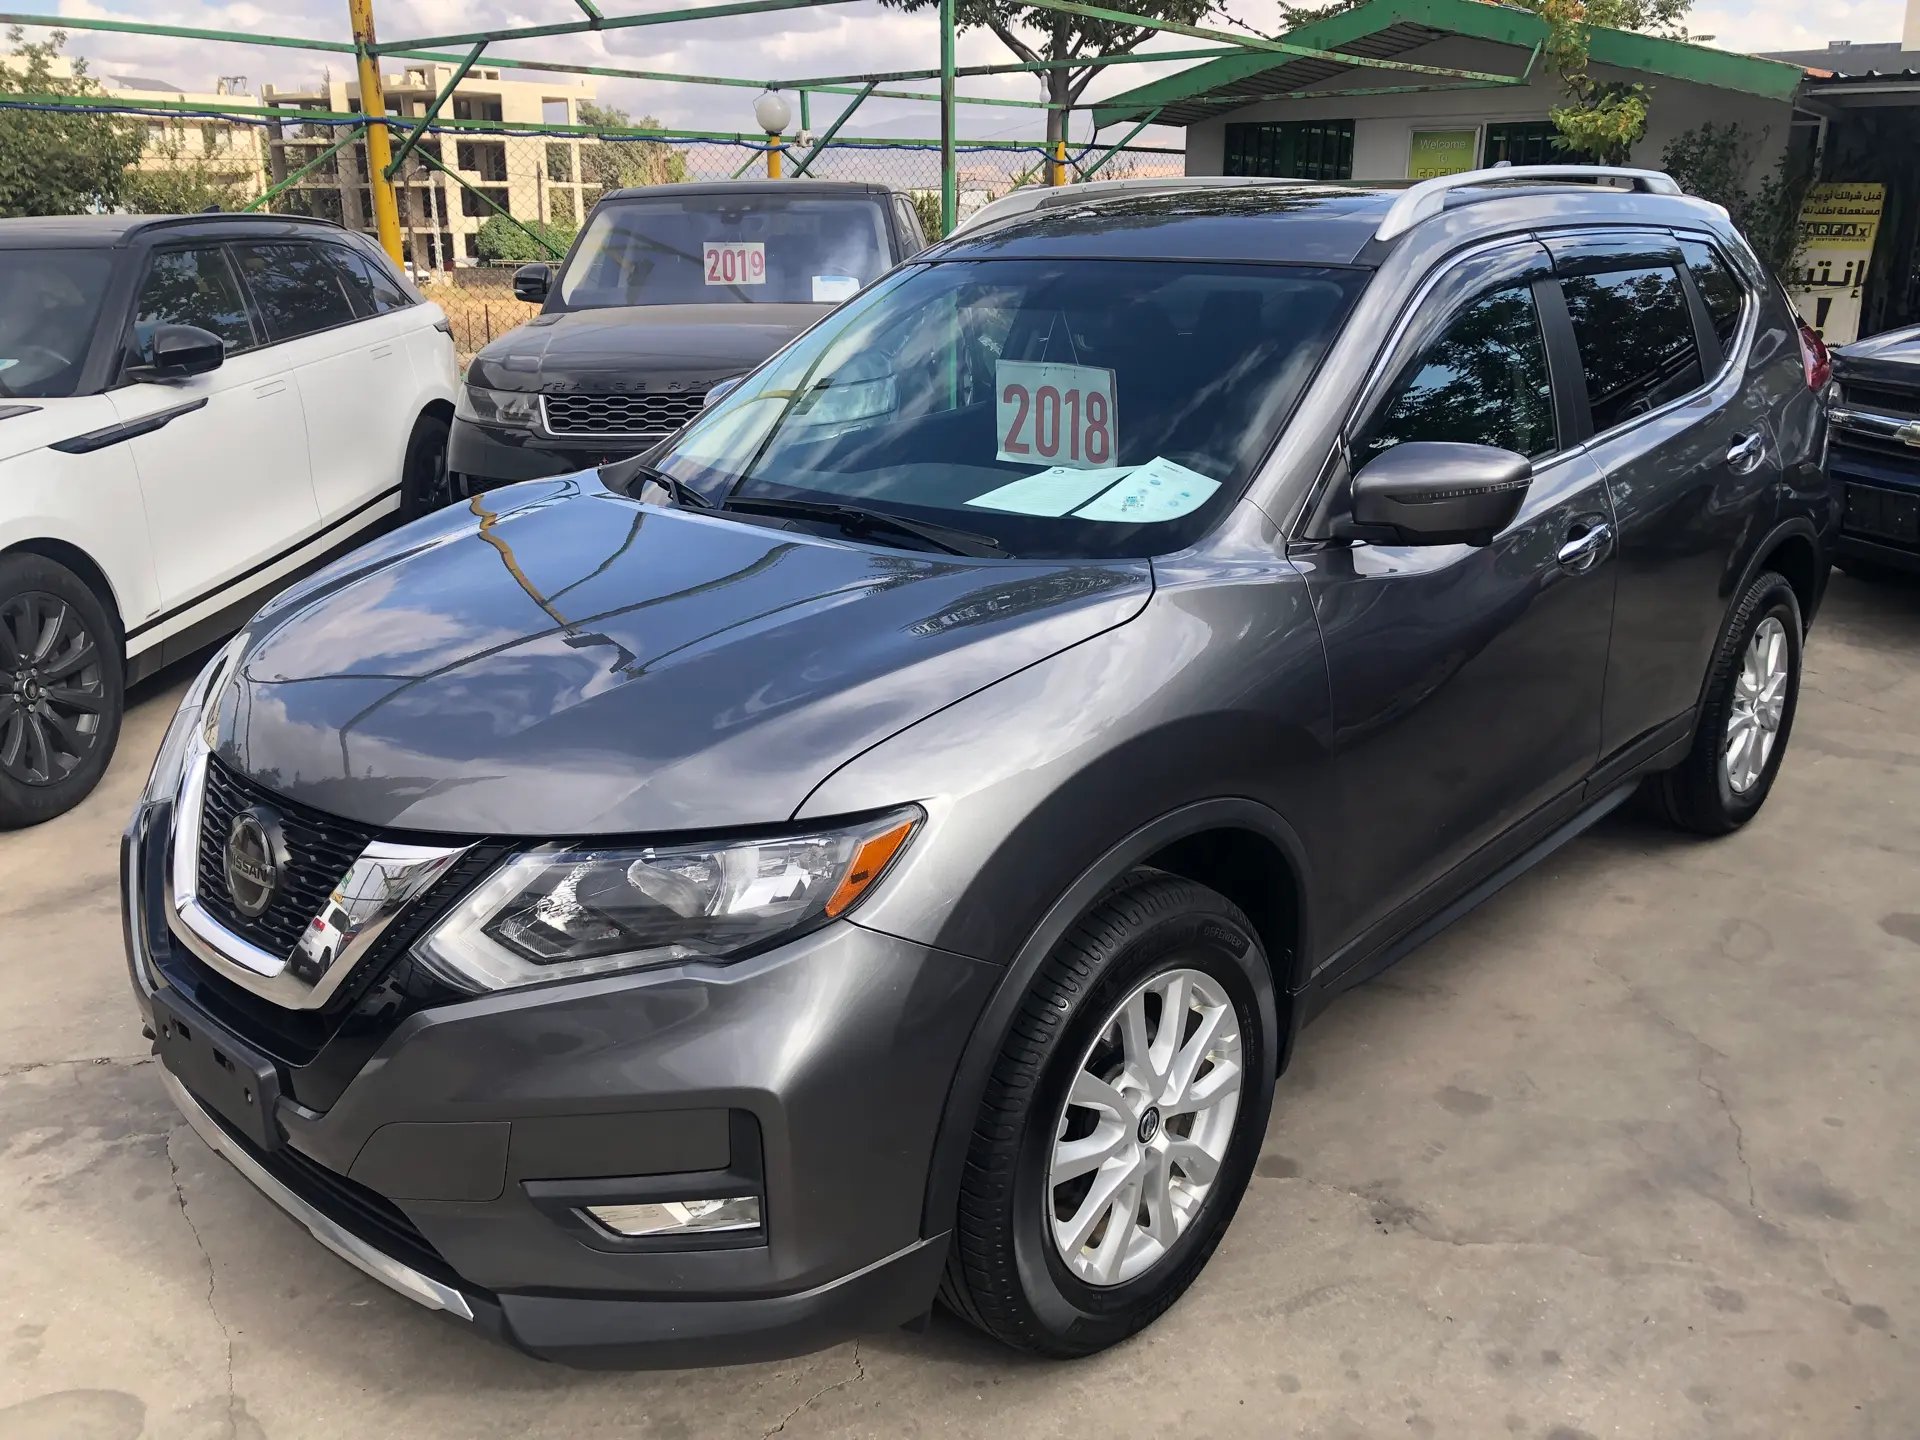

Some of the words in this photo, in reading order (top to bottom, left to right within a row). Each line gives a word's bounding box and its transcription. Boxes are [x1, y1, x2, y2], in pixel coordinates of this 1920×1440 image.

[1420, 139, 1466, 150] Welcome
[1437, 152, 1448, 163] To
[706, 248, 764, 282] 2019
[1003, 383, 1110, 464] 2018
[1204, 925, 1242, 949] DEFENDER
